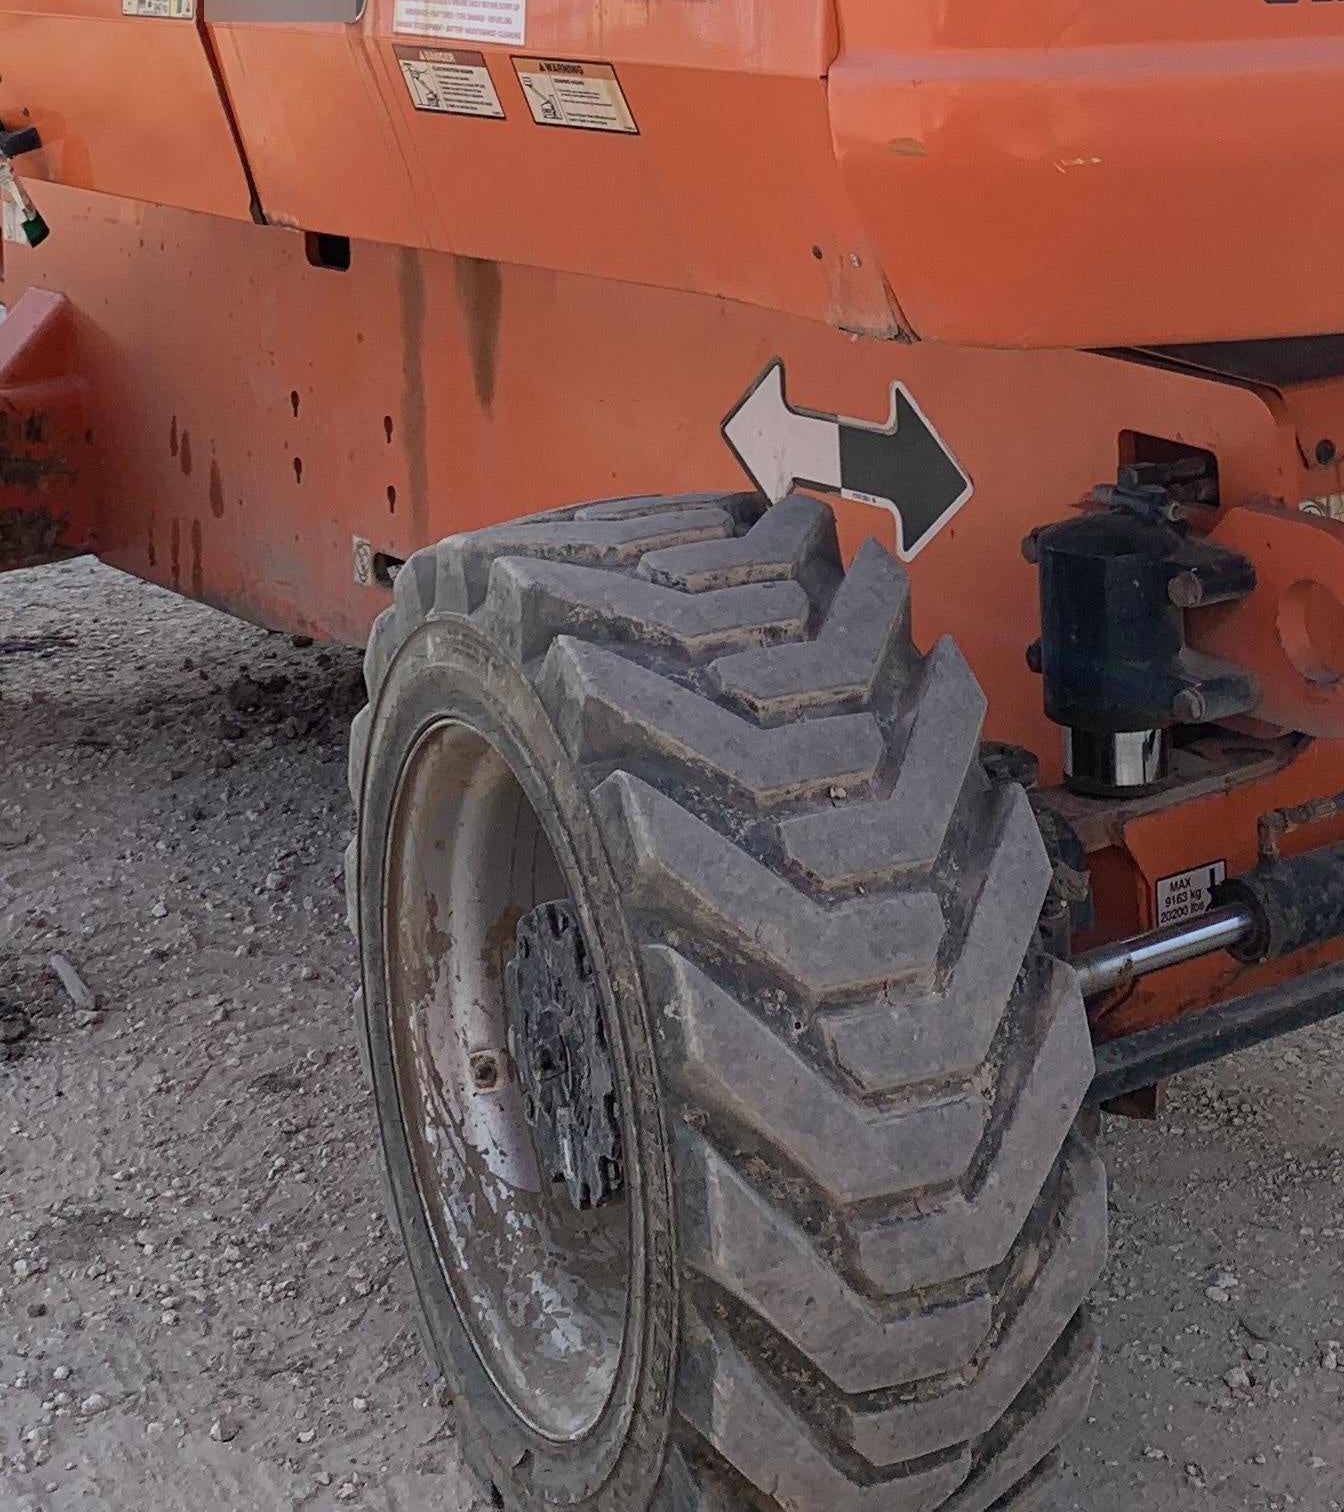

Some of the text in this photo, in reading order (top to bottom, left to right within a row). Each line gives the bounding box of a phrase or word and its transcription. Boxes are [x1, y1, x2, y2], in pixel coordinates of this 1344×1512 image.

[545, 63, 584, 76] WARNING
[1170, 877, 1191, 893] MAX
[1165, 889, 1202, 908] 9163 kg
[1161, 905, 1189, 924] 20200
